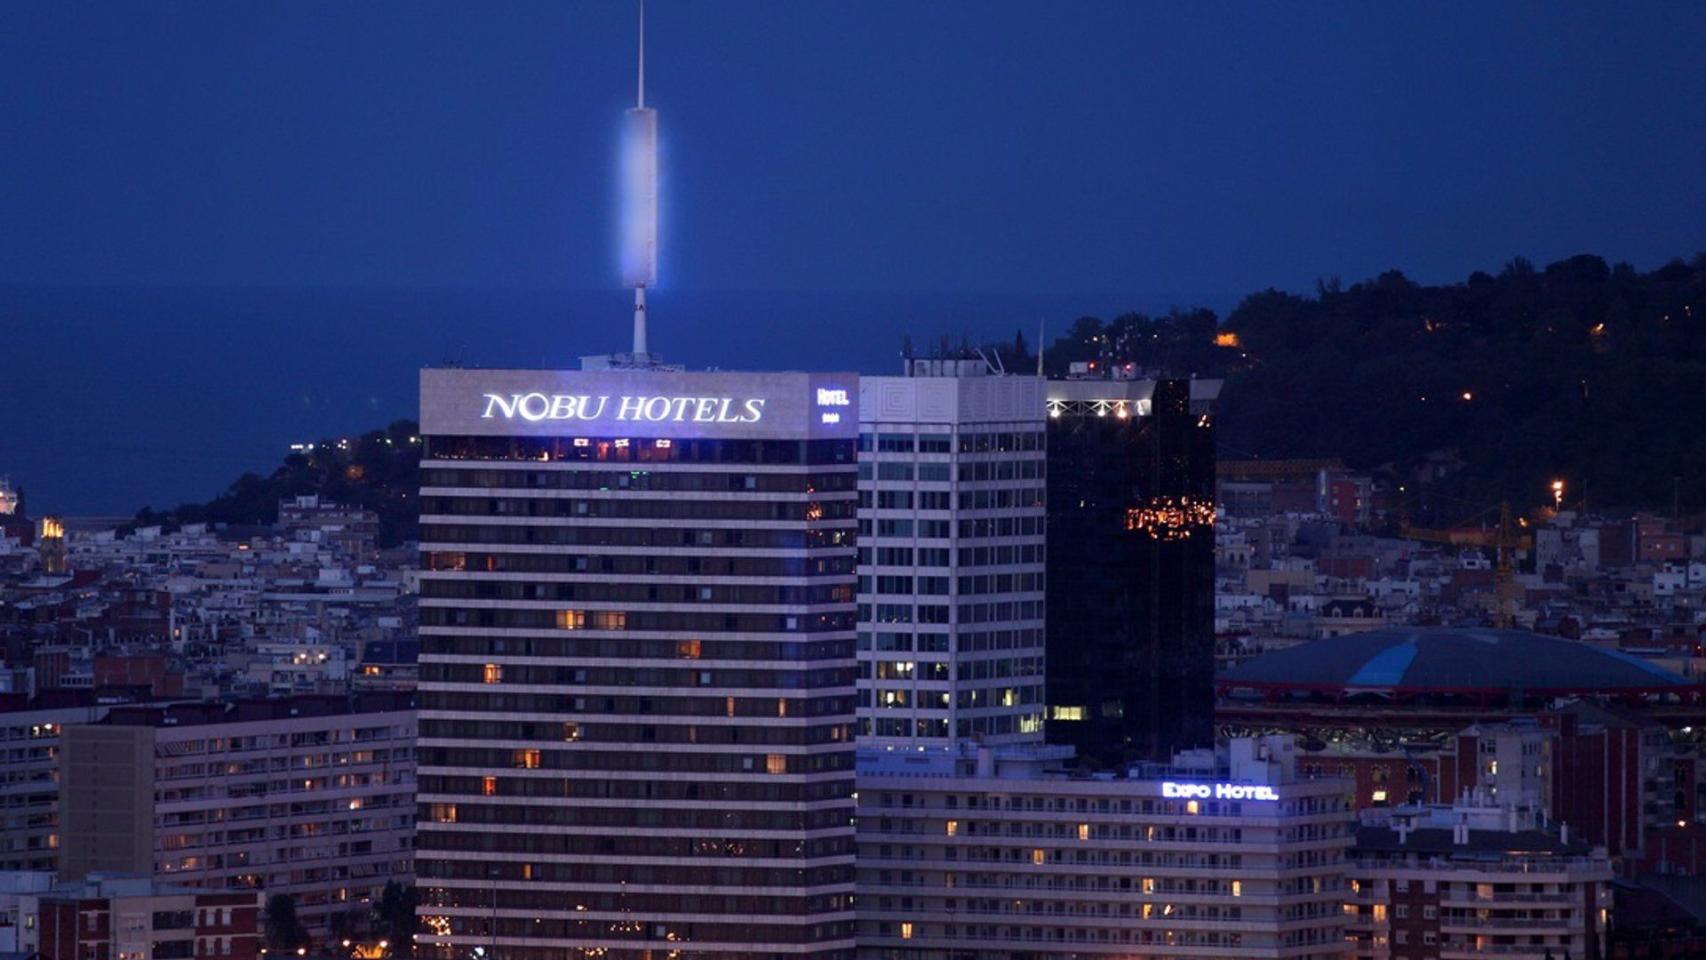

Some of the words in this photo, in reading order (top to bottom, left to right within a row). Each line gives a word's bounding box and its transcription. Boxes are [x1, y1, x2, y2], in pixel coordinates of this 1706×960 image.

[481, 392, 608, 421] NOBU
[615, 397, 765, 423] HOTELS
[1215, 783, 1279, 800] HOTEL
